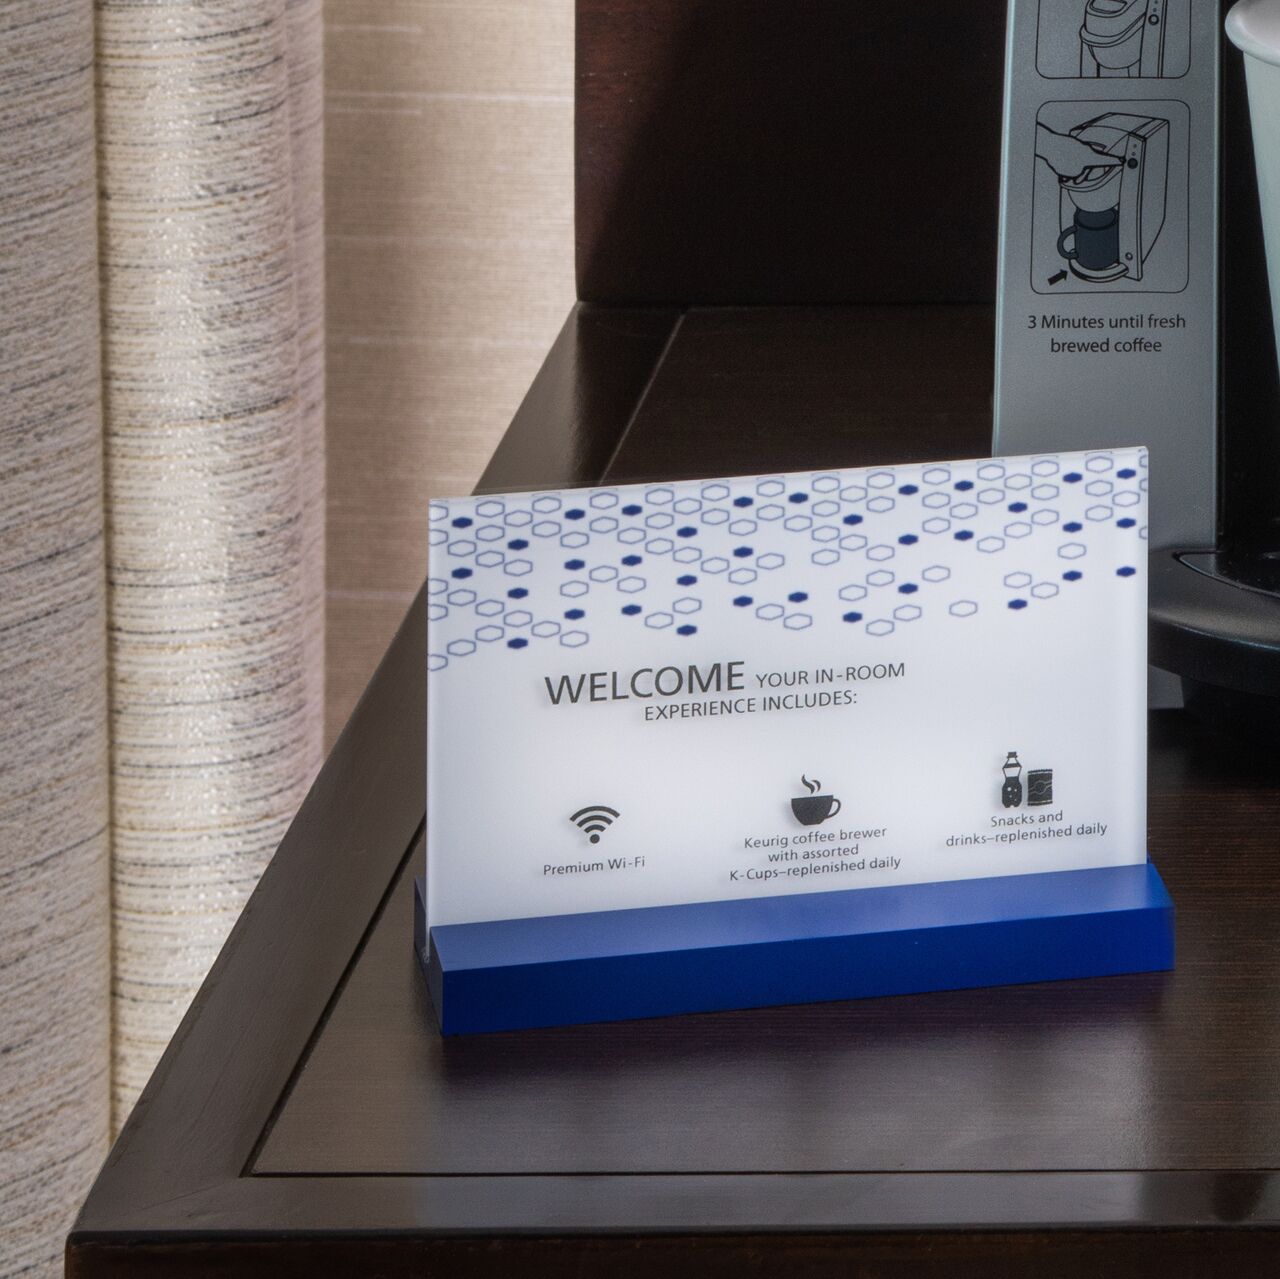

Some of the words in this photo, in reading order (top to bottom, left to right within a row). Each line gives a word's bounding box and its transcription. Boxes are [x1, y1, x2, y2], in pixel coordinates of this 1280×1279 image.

[1027, 315, 1037, 329] 3
[1041, 315, 1105, 329] Minutes
[1109, 314, 1144, 329] until
[1148, 313, 1186, 329] fresh
[1050, 338, 1110, 353] brewed
[1114, 338, 1162, 352] coffee
[544, 660, 746, 705] WELCOME
[756, 669, 809, 689] YOUR
[815, 662, 906, 685] IN-ROOM
[644, 697, 756, 722] EXPERIENCE
[762, 689, 858, 712] INCLUDES:
[990, 813, 1035, 828] Snacks
[1037, 810, 1063, 824] and
[744, 834, 789, 851] Keurig
[792, 830, 835, 846] coffee
[839, 826, 887, 841] brewer
[1076, 822, 1108, 837] daily
[768, 849, 798, 863] with
[802, 843, 859, 860] assorted
[543, 859, 604, 876] Premium
[607, 856, 646, 870] Wi-Fi
[868, 856, 901, 872] daily
